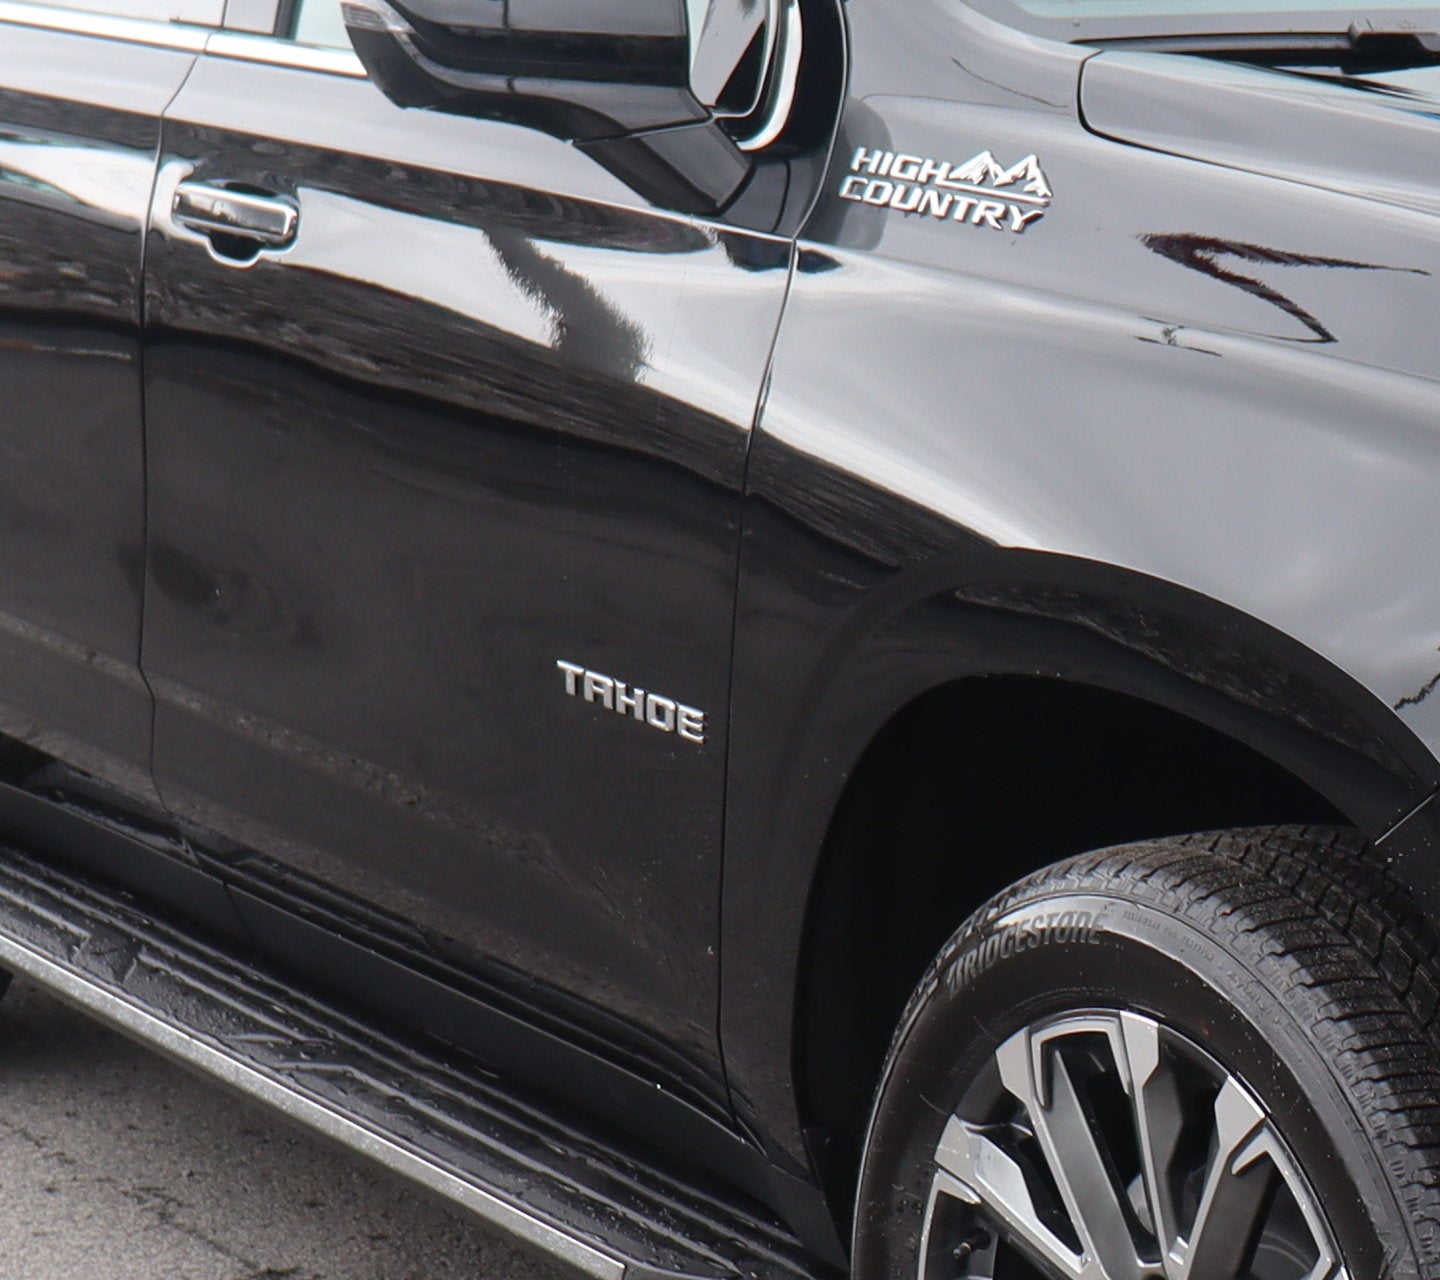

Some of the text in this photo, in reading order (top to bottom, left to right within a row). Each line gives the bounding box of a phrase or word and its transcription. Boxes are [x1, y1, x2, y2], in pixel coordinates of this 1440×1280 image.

[851, 147, 955, 186] HIGH
[839, 175, 1045, 233] COUNTRY
[556, 659, 707, 745] TAHOE
